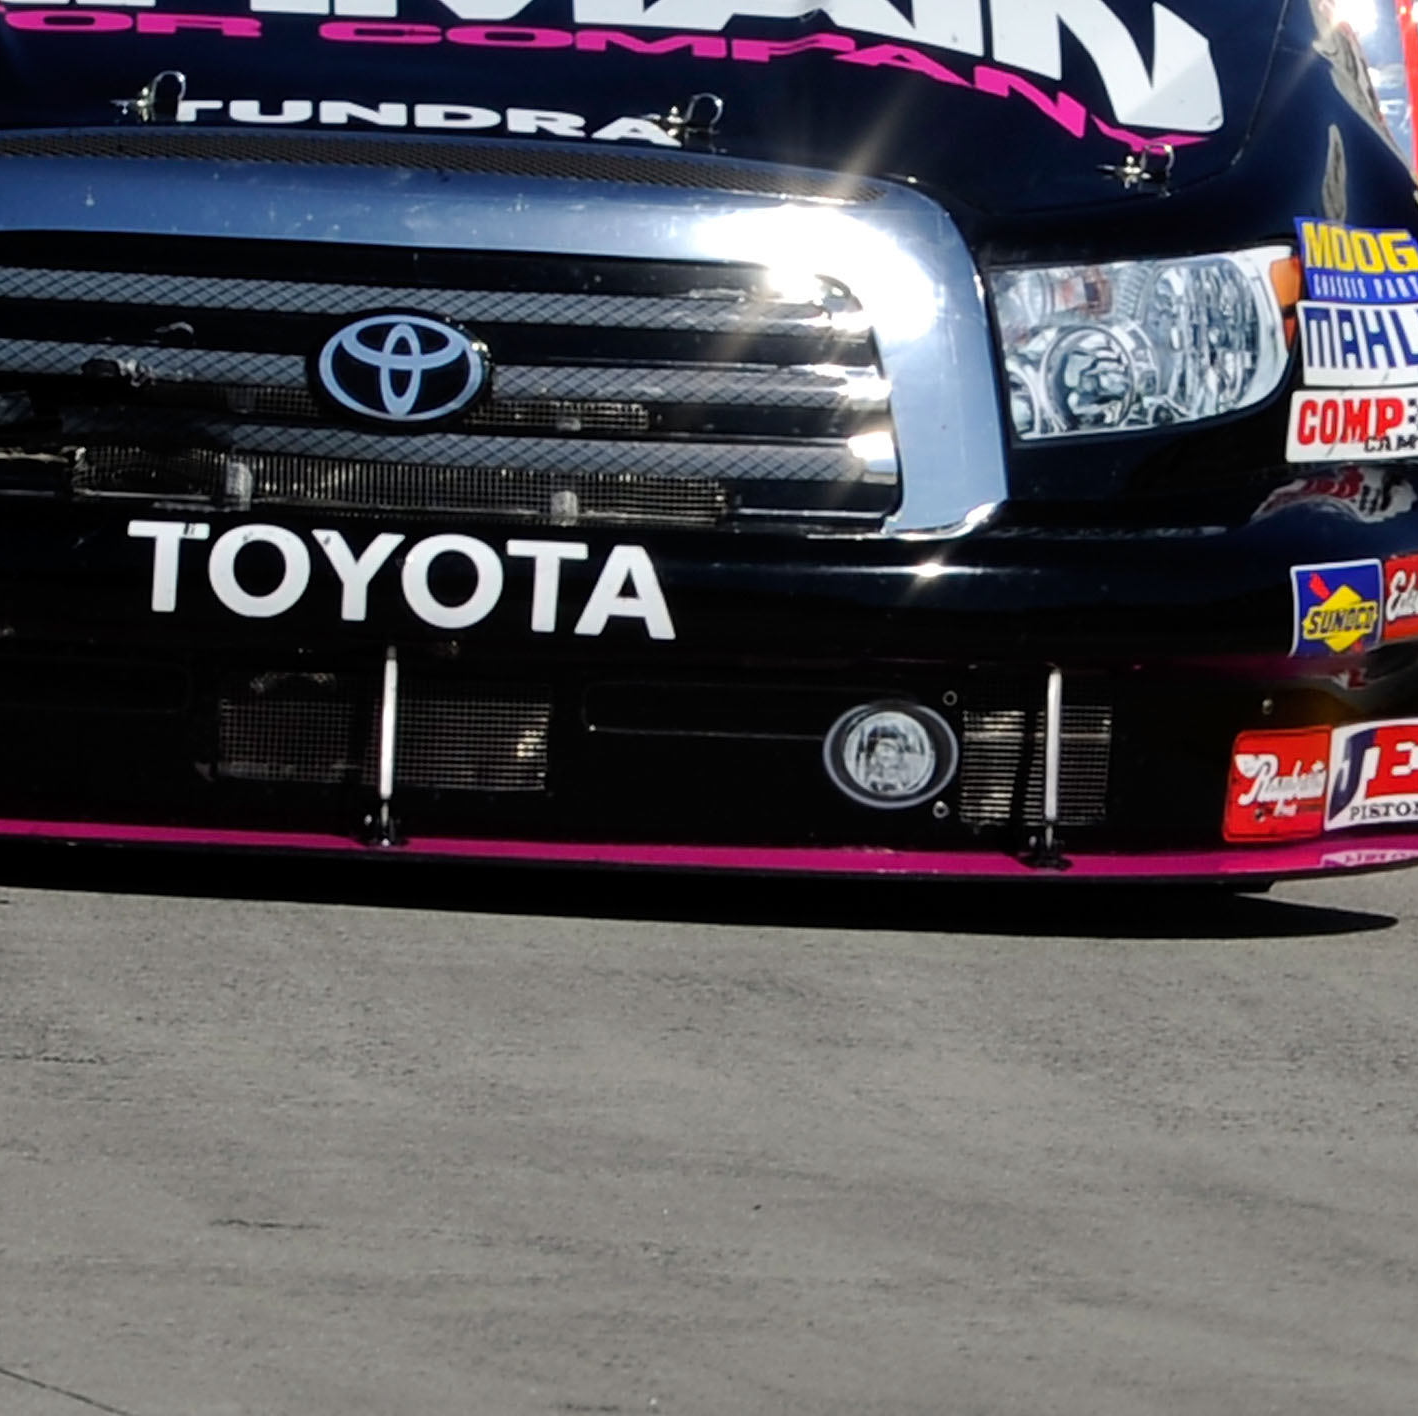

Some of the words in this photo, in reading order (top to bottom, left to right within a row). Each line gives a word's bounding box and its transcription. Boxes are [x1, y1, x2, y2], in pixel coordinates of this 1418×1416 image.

[319, 20, 1210, 151] COMPANY
[176, 100, 682, 147] TUNDRA
[1297, 397, 1404, 446] COMP
[128, 520, 676, 641] TOYOTA
[1307, 605, 1376, 635] SUNOCO
